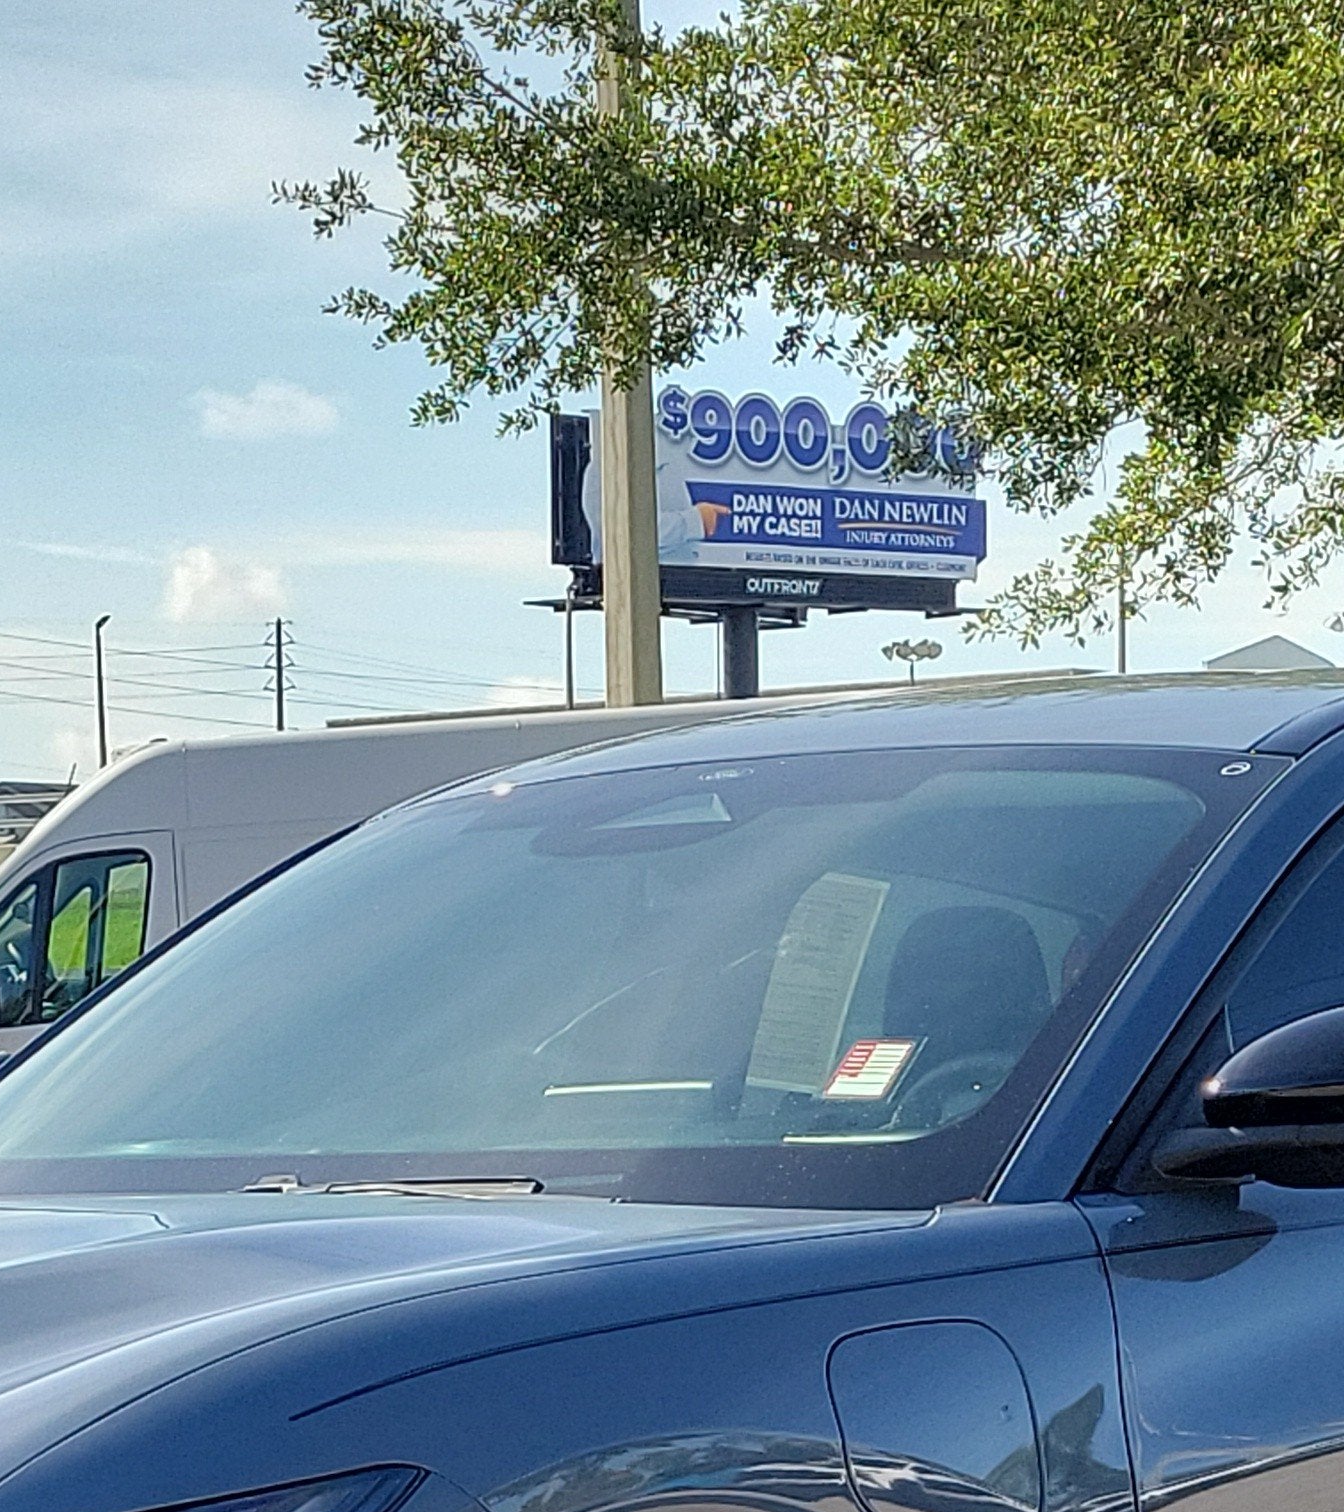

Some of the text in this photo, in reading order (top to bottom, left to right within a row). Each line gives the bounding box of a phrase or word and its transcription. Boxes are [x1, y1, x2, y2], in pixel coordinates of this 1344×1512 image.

[733, 494, 822, 517] DAN WON
[834, 497, 968, 527] DAN NEWLIN
[733, 515, 761, 535] MY
[846, 530, 955, 548] INJURY ATTORNEYS
